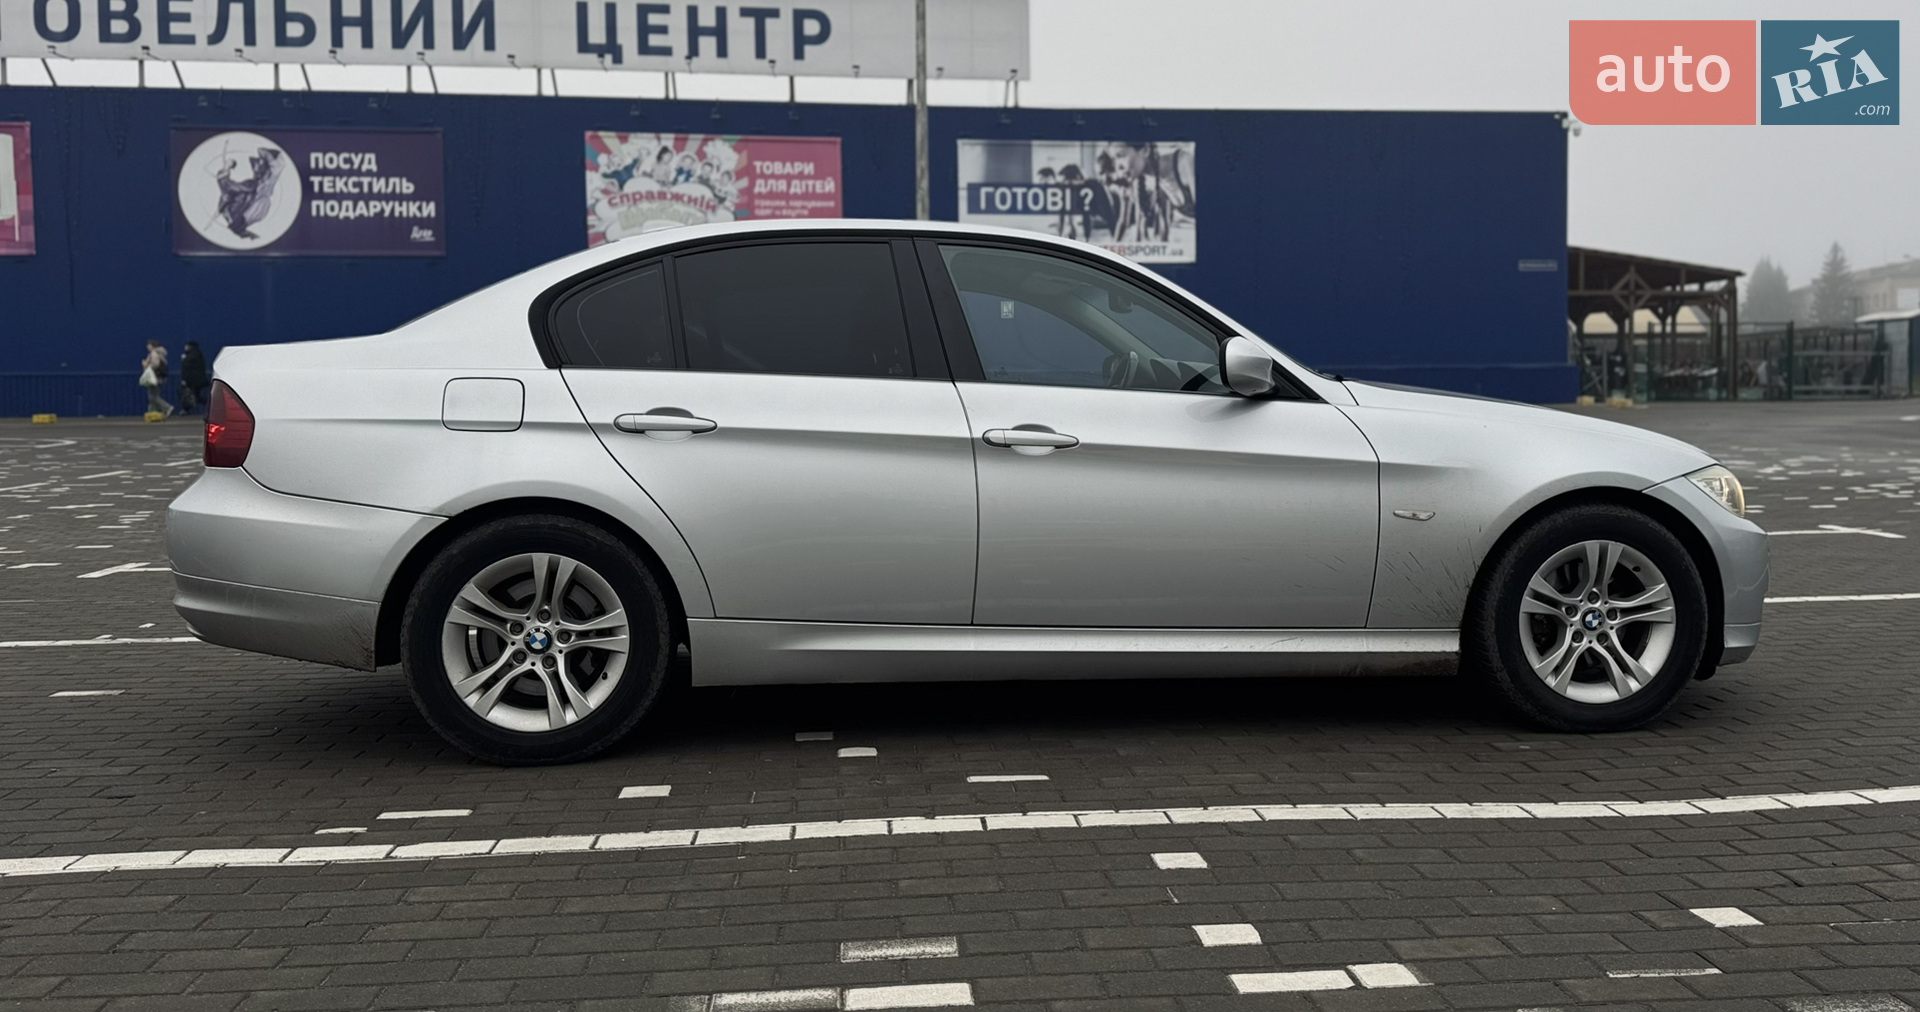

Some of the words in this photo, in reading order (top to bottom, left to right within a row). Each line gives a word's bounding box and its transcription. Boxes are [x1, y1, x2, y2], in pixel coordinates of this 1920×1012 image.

[576, 1, 832, 64] ЦЕНТР
[309, 152, 378, 172] ПОСУД
[752, 161, 815, 176] ТОВАРИ
[309, 176, 415, 194] ТЕКСТИЛЬ
[754, 178, 788, 195] ДЛЯ
[789, 176, 836, 196] ДІТЕЙ
[979, 186, 1072, 212] ГОТОВІ
[1079, 187, 1094, 212] ?
[311, 200, 436, 219] ПОДАРУНКИ
